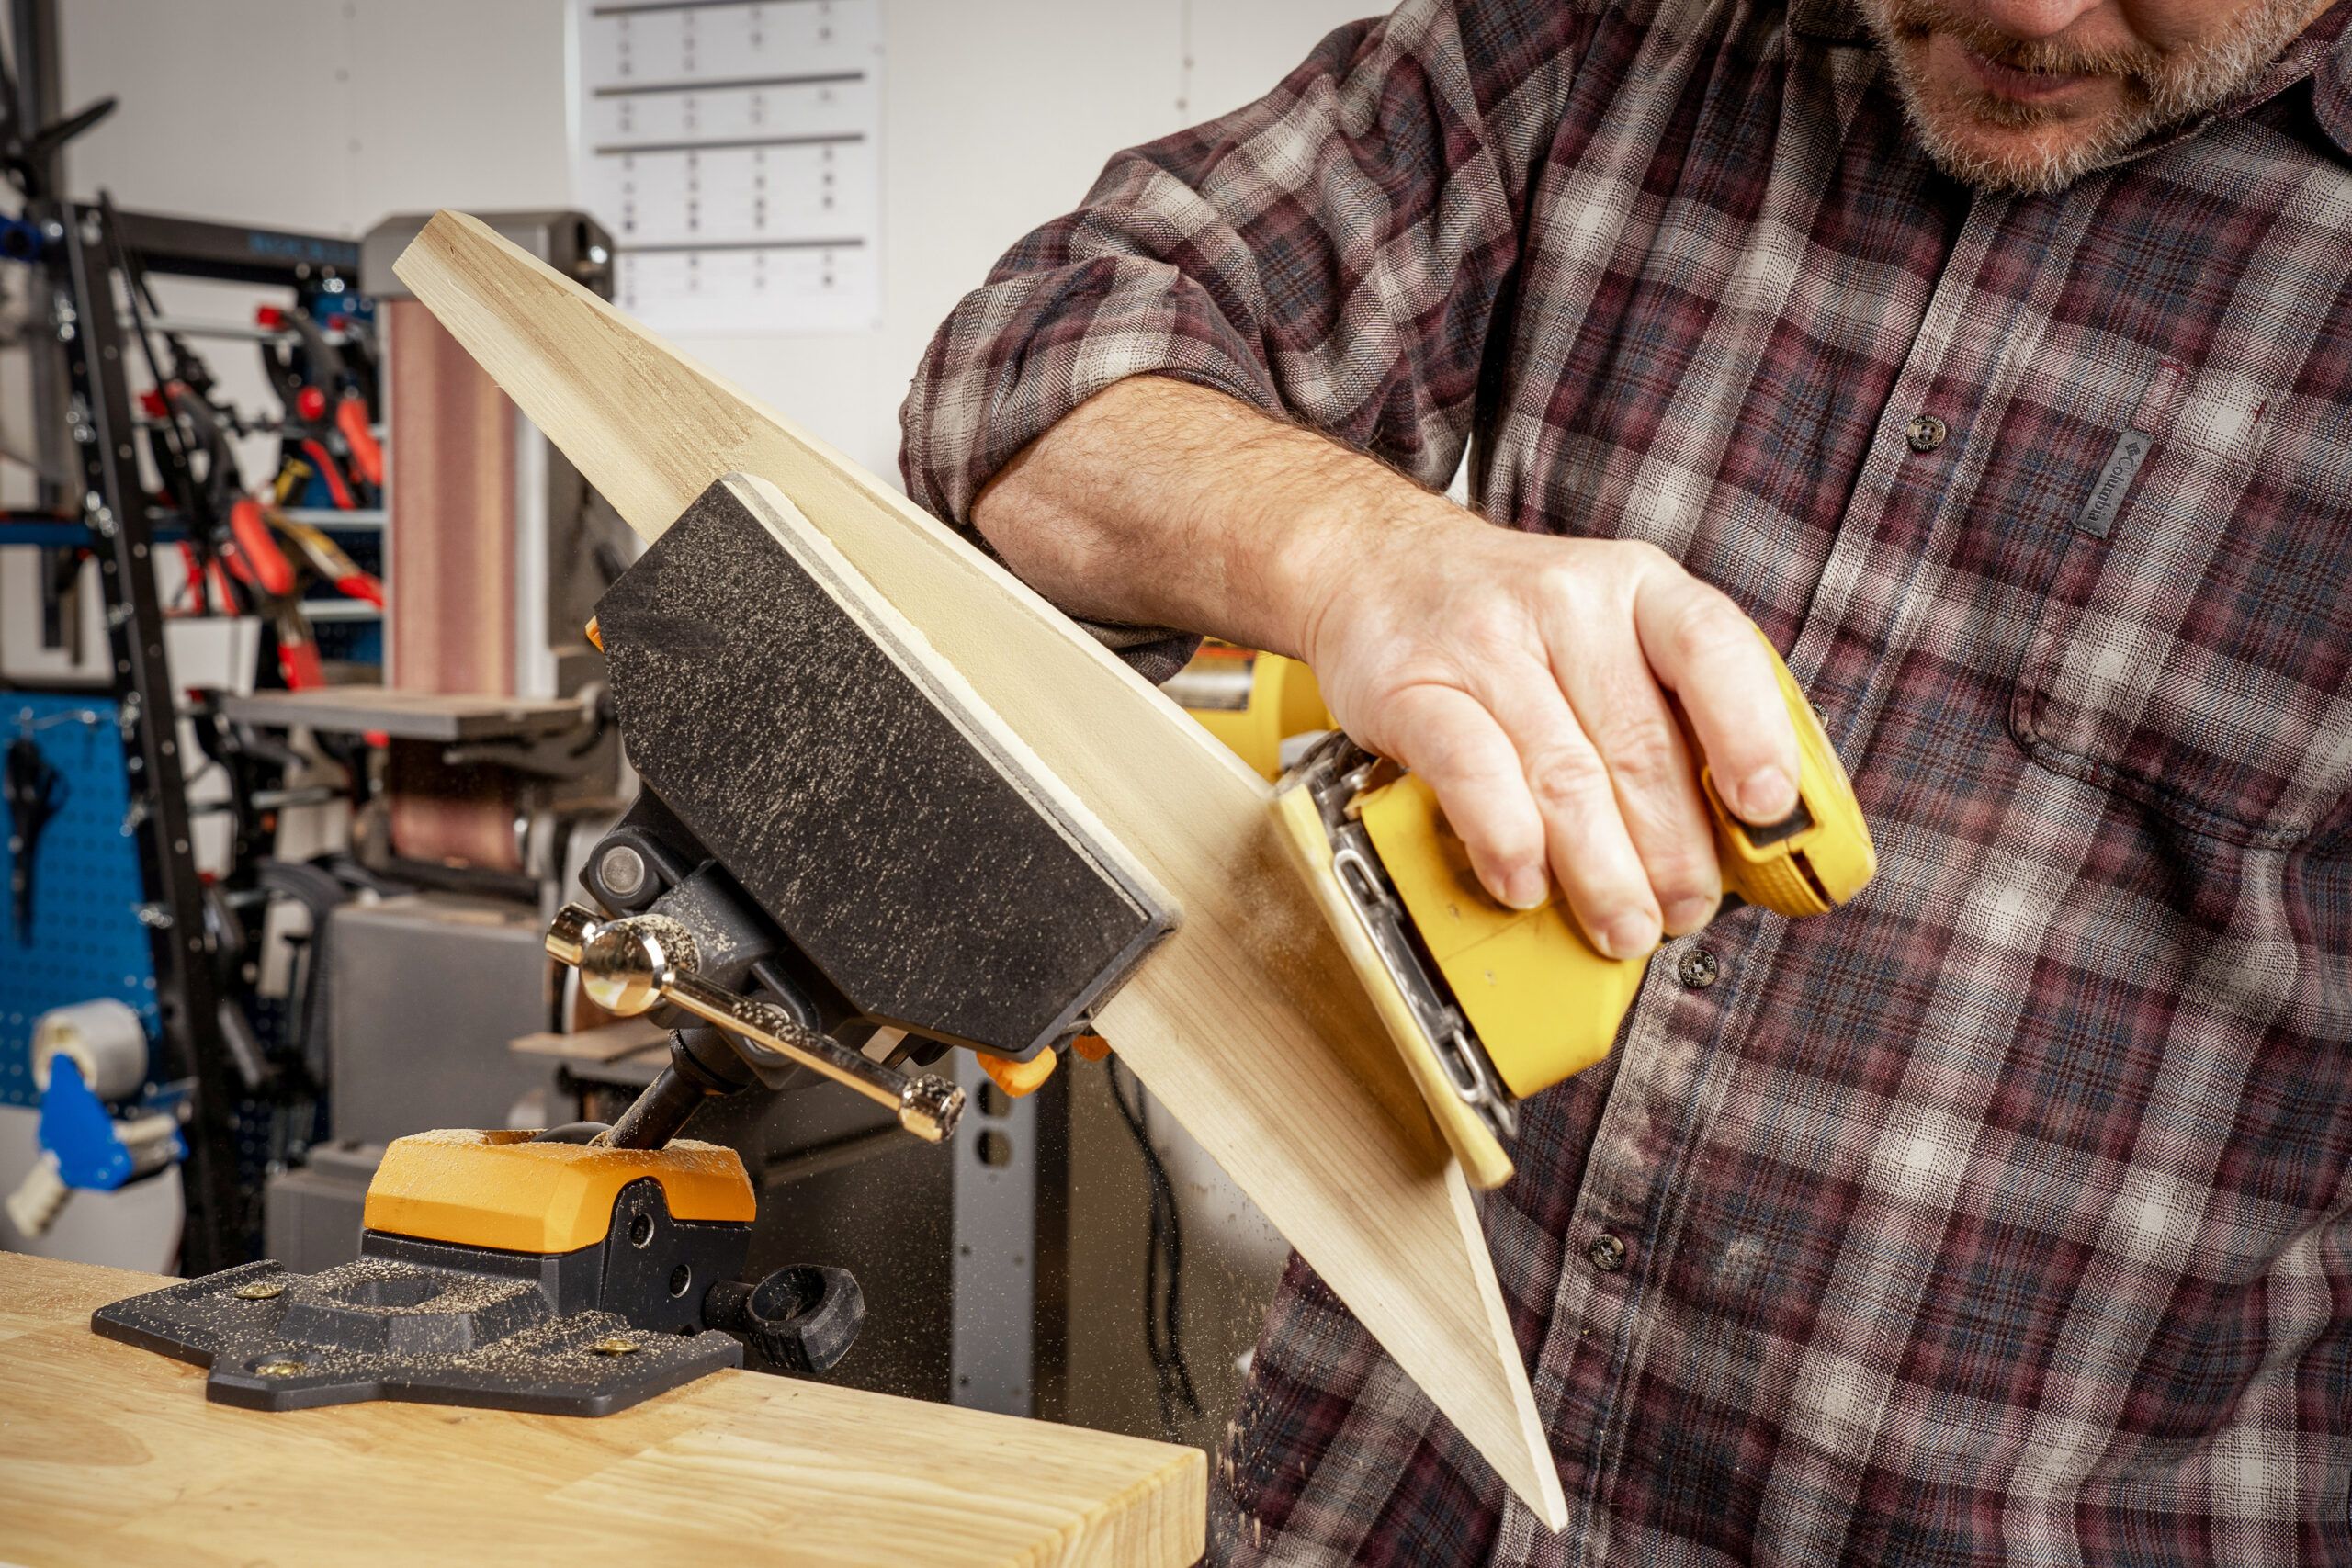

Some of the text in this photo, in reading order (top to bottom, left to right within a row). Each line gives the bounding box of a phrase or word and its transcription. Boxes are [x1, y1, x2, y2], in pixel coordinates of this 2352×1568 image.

[1914, 415, 1945, 433] OLUMBIA
[2086, 456, 2134, 522] Columbia
[1810, 701, 1827, 720] UMBIA
[1680, 952, 1702, 982] COLUMBIA
